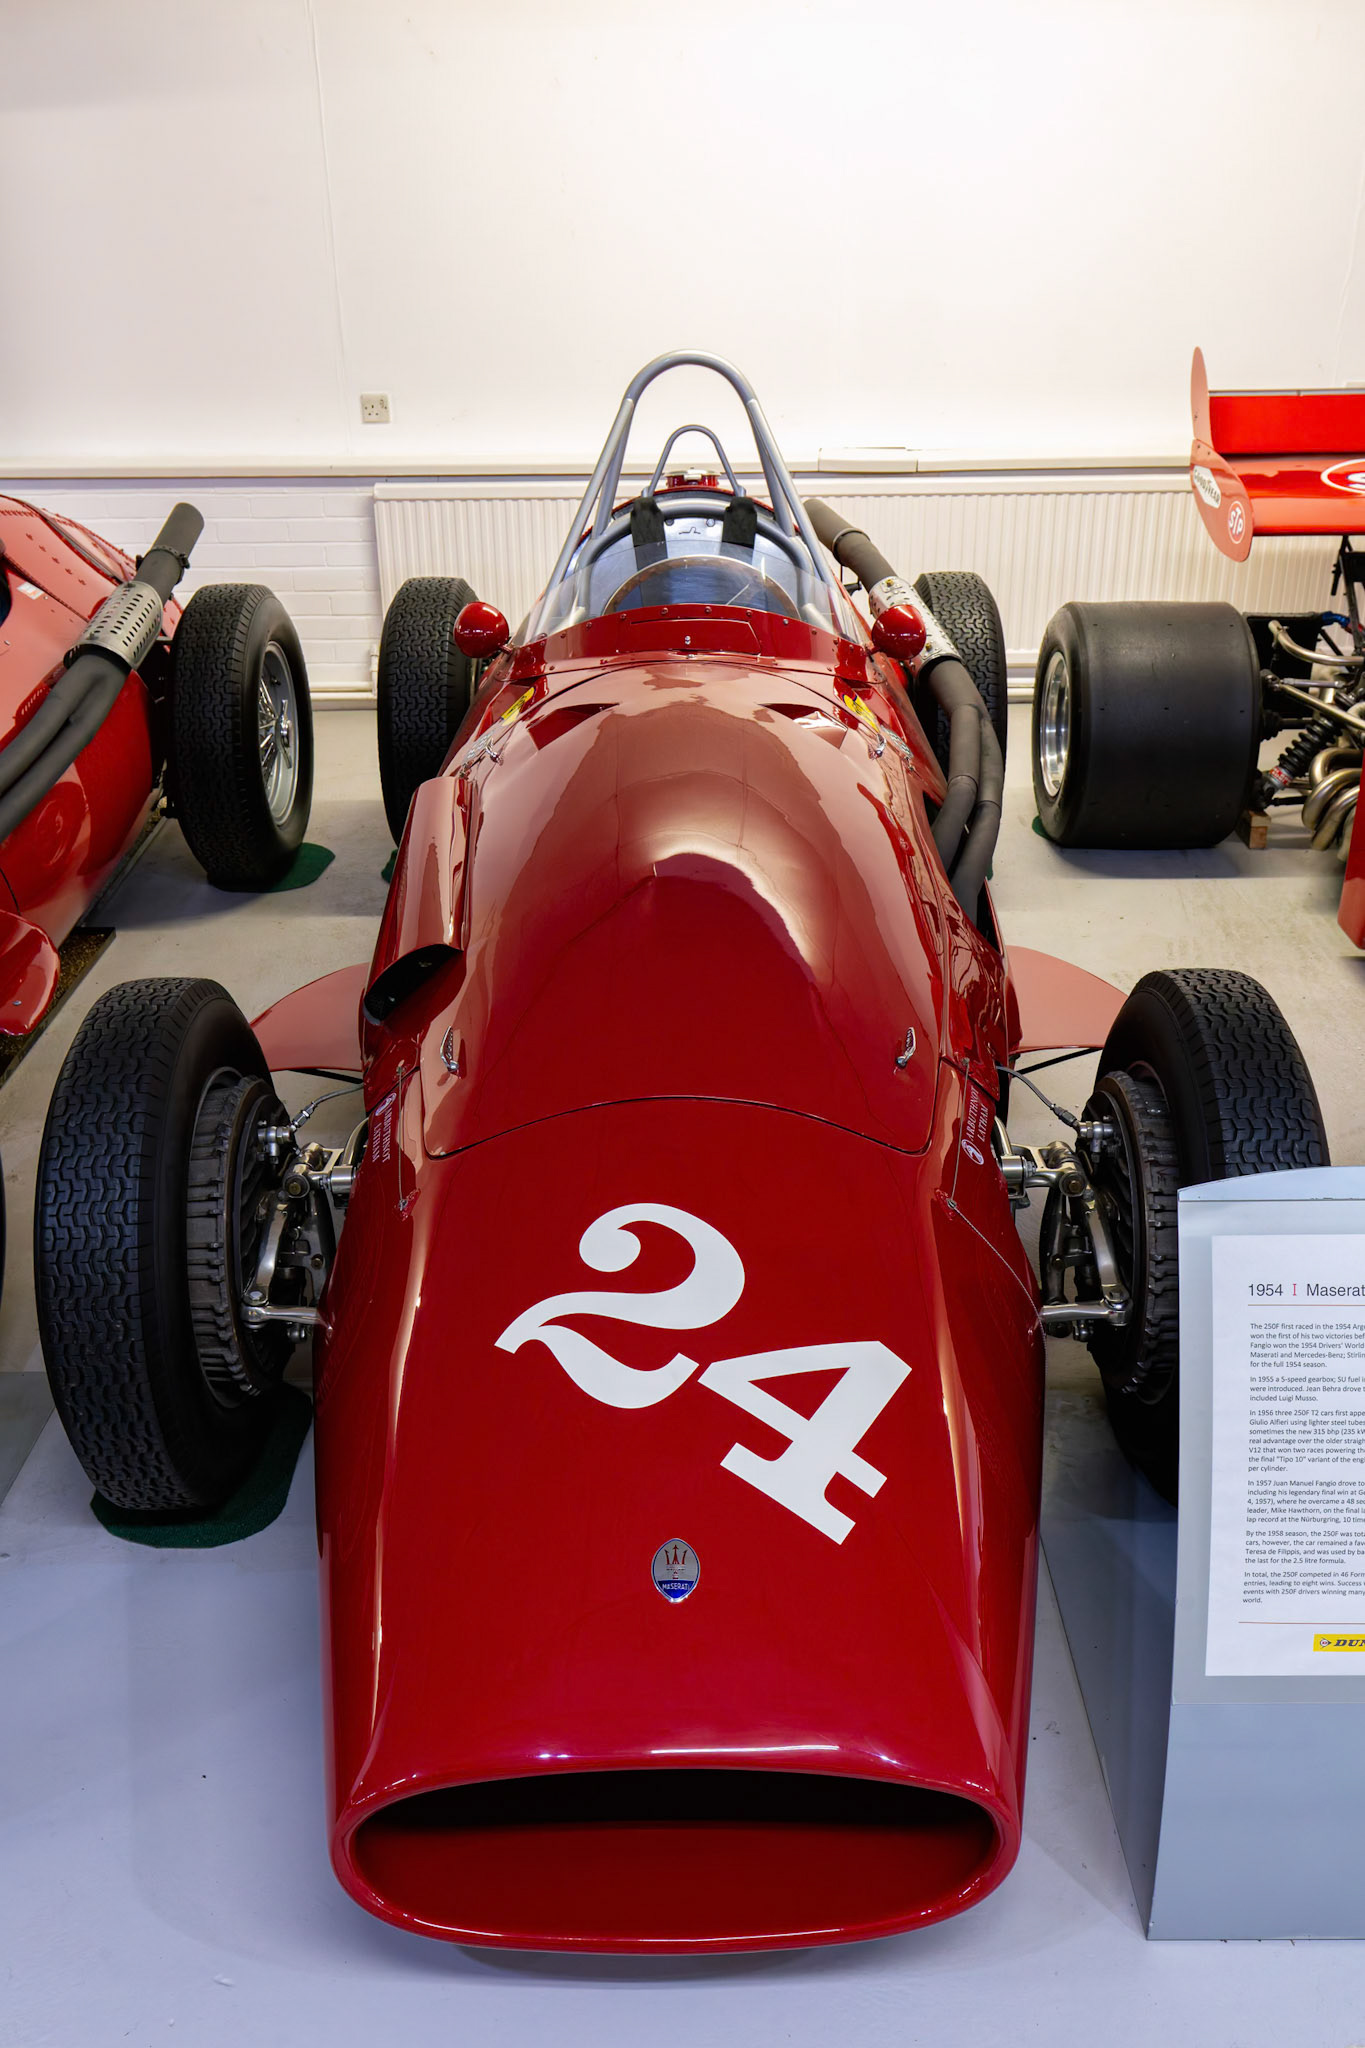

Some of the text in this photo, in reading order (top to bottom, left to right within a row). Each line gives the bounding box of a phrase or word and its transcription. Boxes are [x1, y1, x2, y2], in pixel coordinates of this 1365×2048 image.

[1228, 506, 1244, 536] STP
[966, 1086, 979, 1141] ARBUTHNOT
[977, 1103, 989, 1142] LATHAM
[1248, 1283, 1284, 1297] 1954
[1250, 1342, 1272, 1350] Fangio
[1250, 1360, 1259, 1368] for
[1261, 1360, 1272, 1368] the
[494, 1202, 912, 1545] 24
[1281, 1376, 1307, 1384] 5-speed
[1278, 1395, 1294, 1403] Luigi
[1290, 1419, 1307, 1427] using
[1308, 1419, 1330, 1427] lighter
[1326, 1428, 1340, 1436] bhp
[1340, 1428, 1356, 1436] (235
[1315, 1480, 1337, 1488] Fangio
[1247, 1489, 1277, 1497] including
[1288, 1489, 1321, 1497] legendary
[662, 1582, 691, 1591] MASERATI
